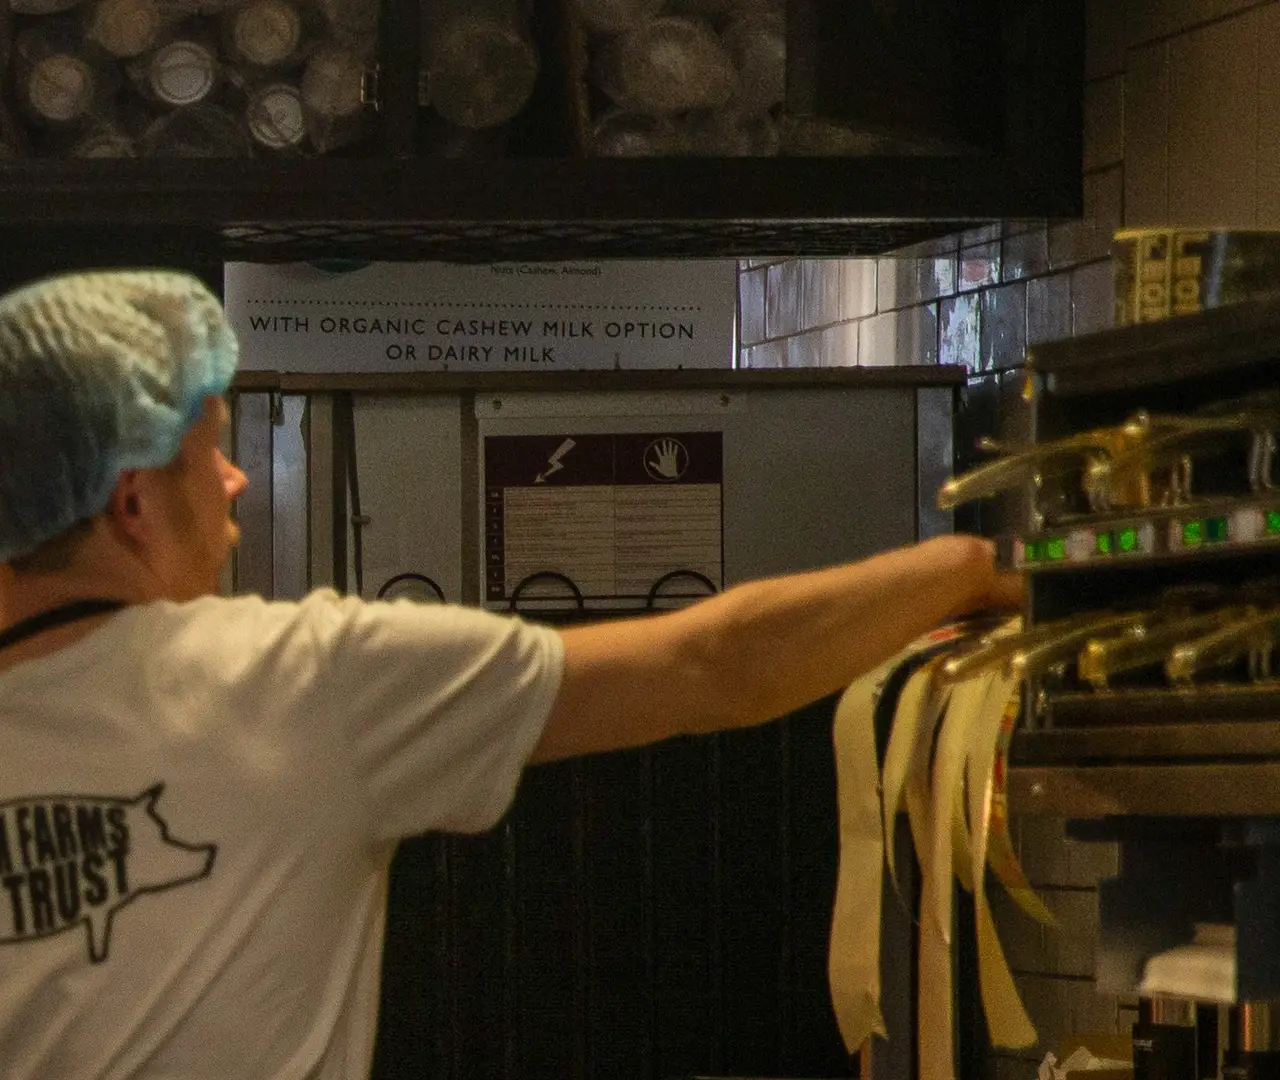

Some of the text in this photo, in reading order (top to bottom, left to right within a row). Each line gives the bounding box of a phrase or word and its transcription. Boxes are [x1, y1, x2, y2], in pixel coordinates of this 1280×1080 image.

[490, 265, 514, 275] Nuts
[561, 266, 602, 278] Almond)
[249, 315, 694, 340] WITH ORGANIC CASHEW MILK OPTION
[385, 344, 556, 363] OR DAIRY MILK
[15, 804, 130, 868] FARMS
[2, 850, 129, 935] TRUST
